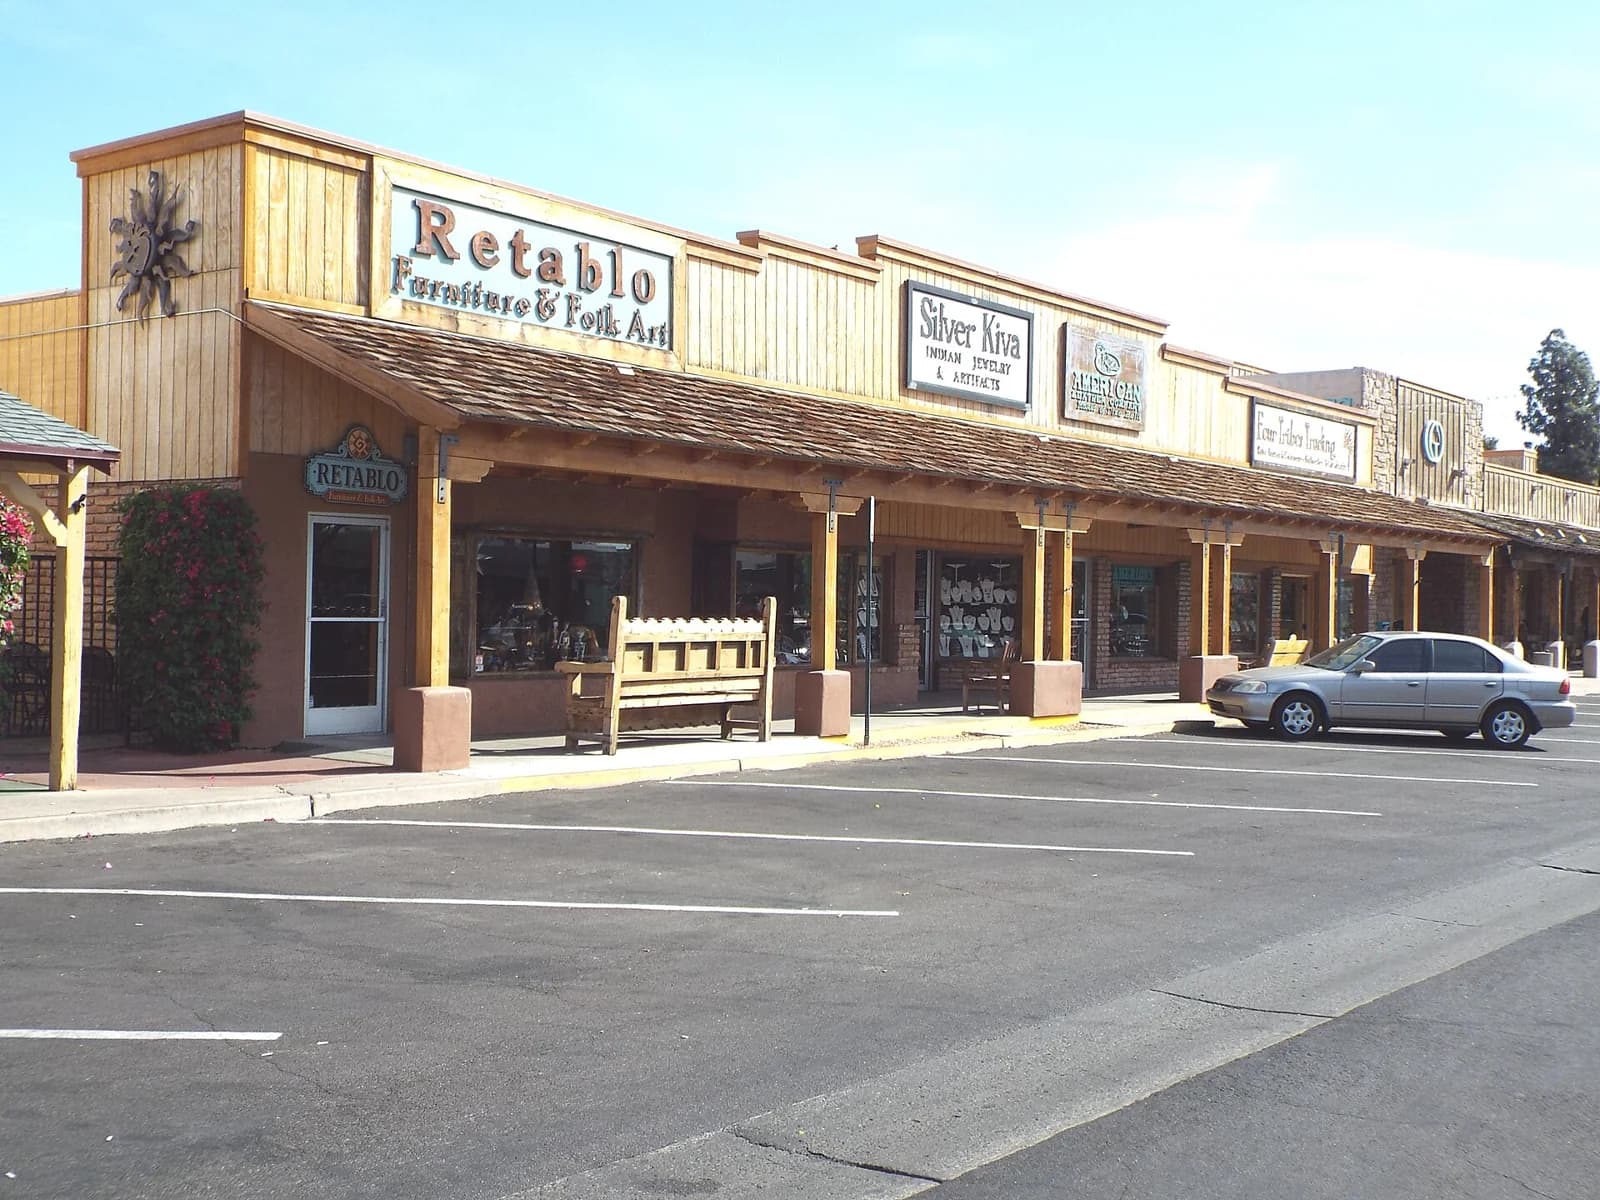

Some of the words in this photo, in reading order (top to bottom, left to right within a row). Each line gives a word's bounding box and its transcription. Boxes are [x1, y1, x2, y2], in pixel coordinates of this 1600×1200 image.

[410, 198, 656, 304] Retablo
[392, 254, 531, 318] Furniture
[535, 286, 560, 321] &
[565, 291, 621, 338] Folk
[625, 308, 669, 348] Art
[920, 296, 976, 348] Silver
[982, 312, 1021, 360] Kiva
[925, 345, 962, 365] INDIAN
[972, 356, 1012, 376] JEWELRY
[936, 365, 944, 380] &
[953, 371, 1001, 391] ARTIFACTS
[1071, 370, 1142, 403] AMERICAN
[316, 462, 400, 491] RETABLO
